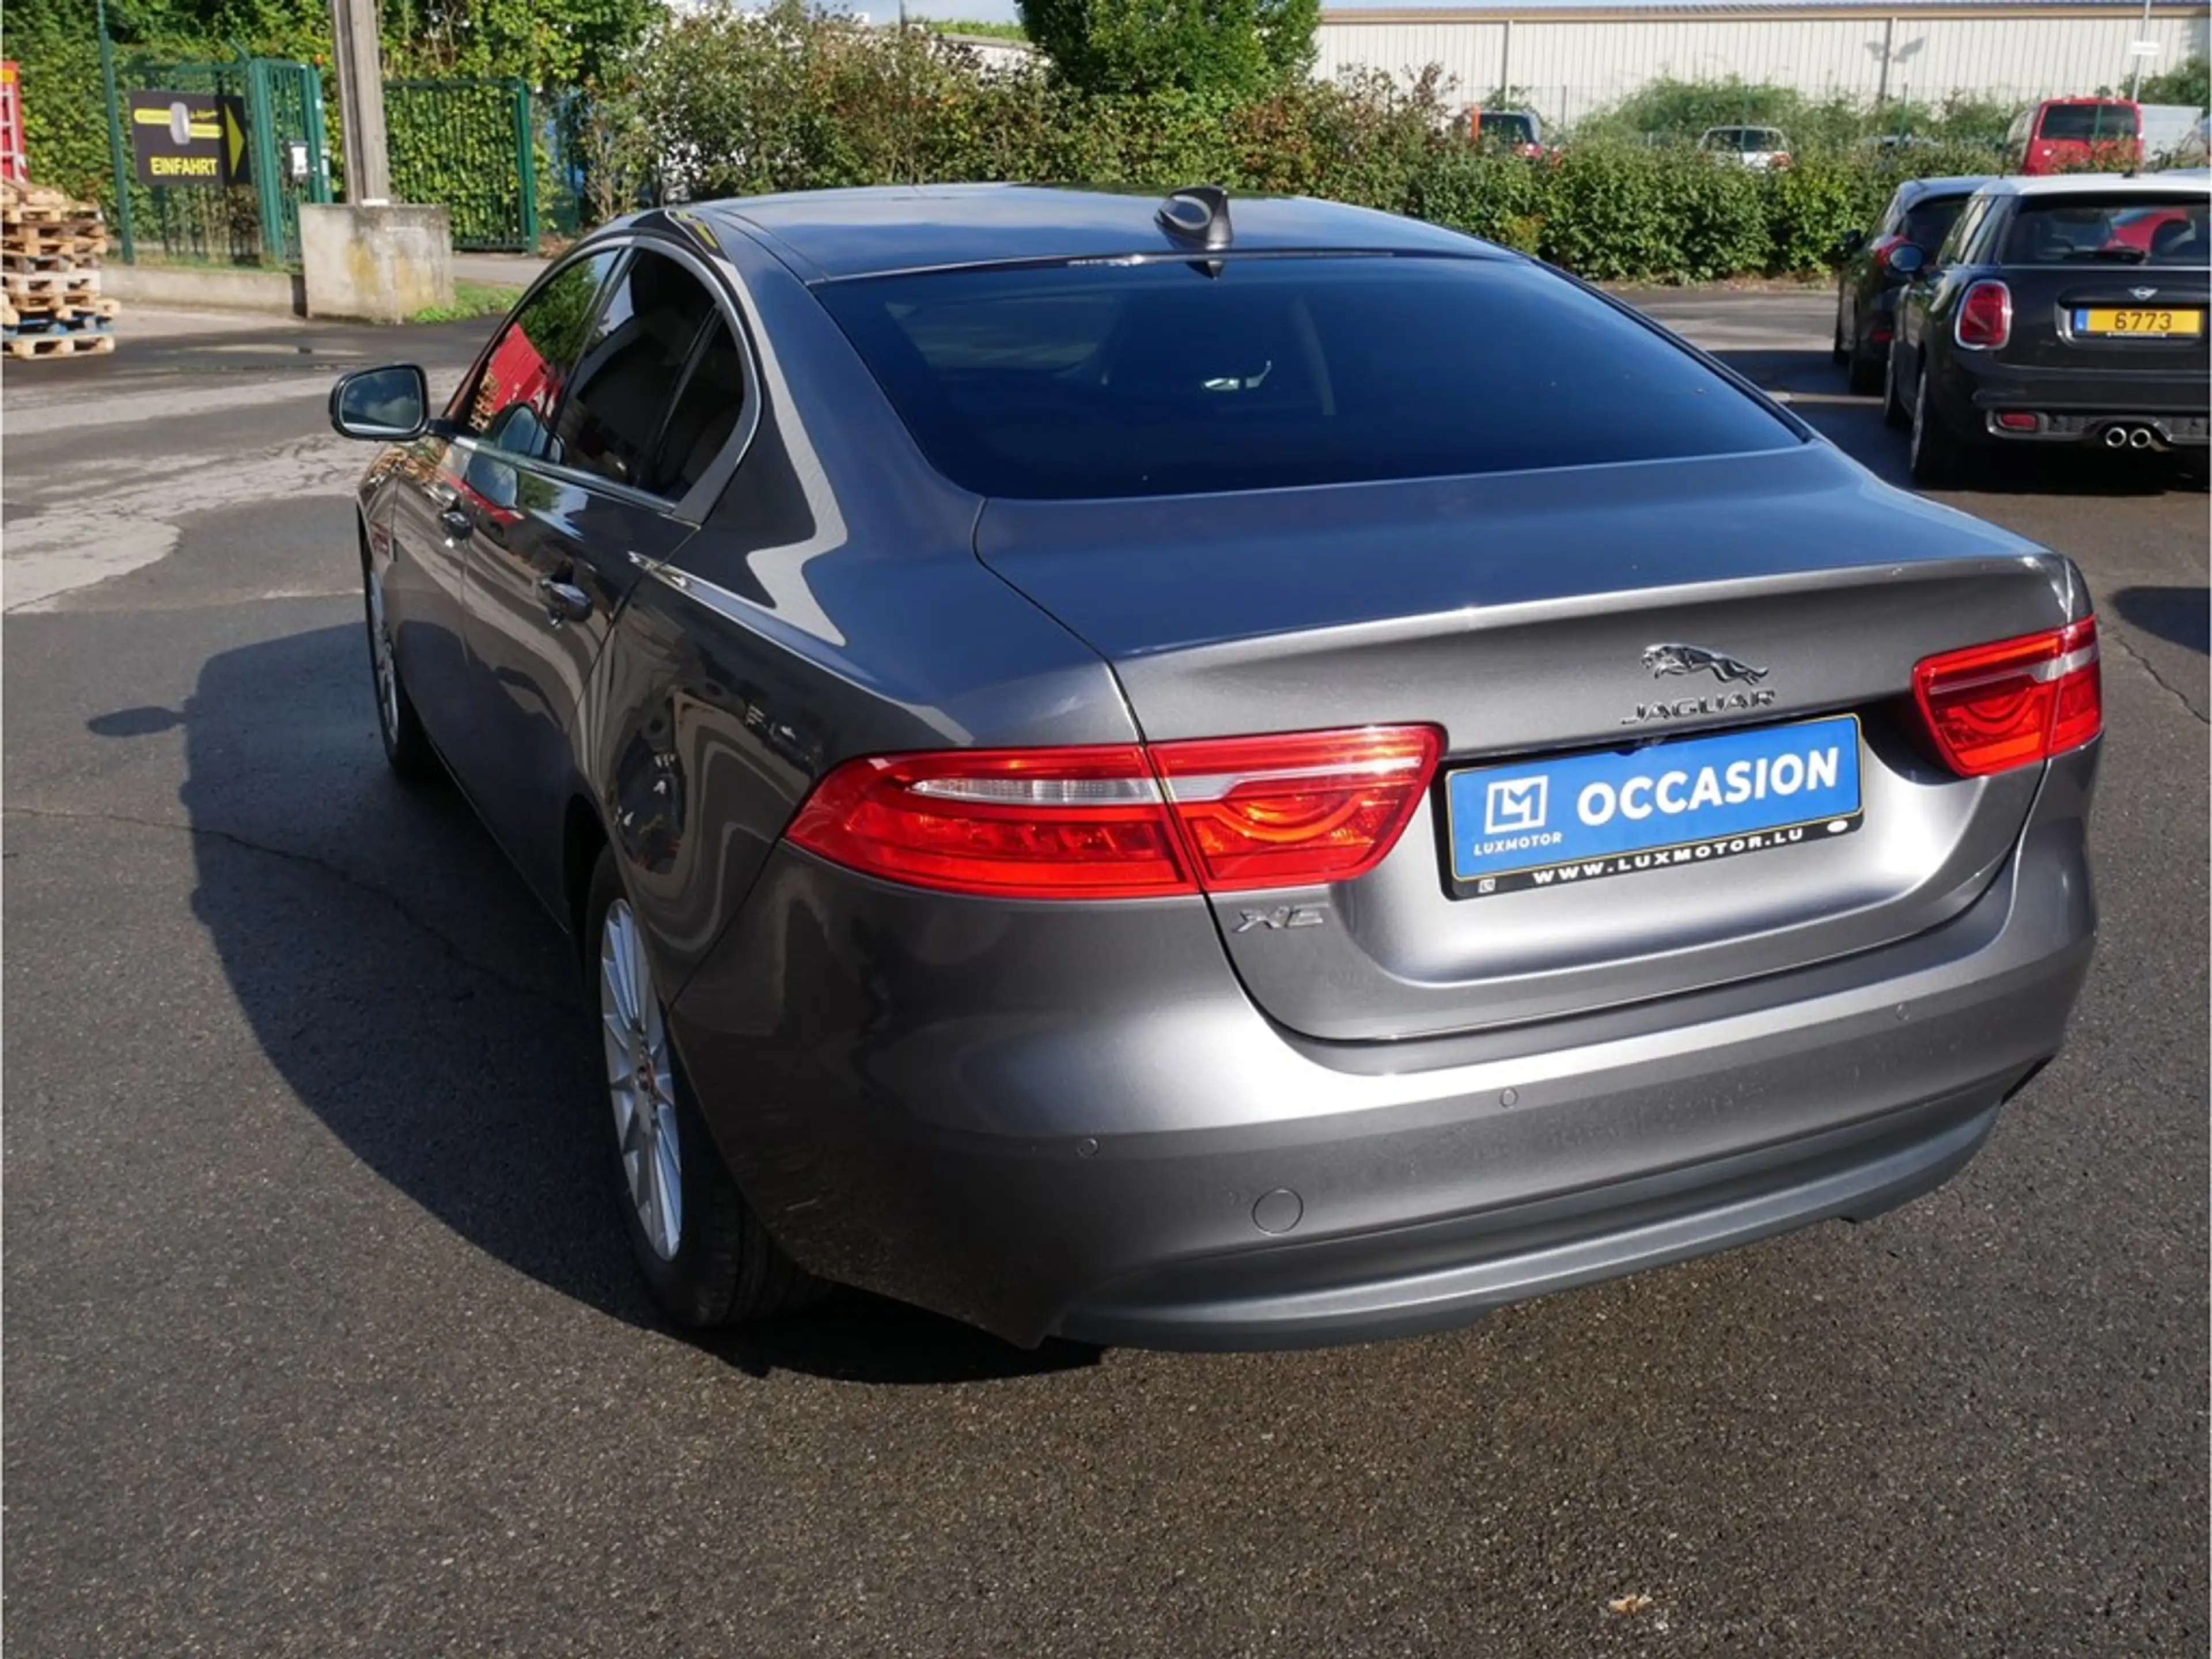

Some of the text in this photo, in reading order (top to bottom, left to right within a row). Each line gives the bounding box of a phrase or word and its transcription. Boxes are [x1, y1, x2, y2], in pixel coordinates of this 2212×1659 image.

[150, 157, 218, 176] EINFAHRT
[2115, 311, 2172, 330] 6773
[1621, 688, 1775, 725] JAGUAR
[1577, 747, 1839, 827] OCCASION
[1474, 831, 1563, 856] LUXMOTOR
[1532, 828, 1804, 884] WWW.LUXMOTOR.LU
[1231, 902, 1330, 933] XE
